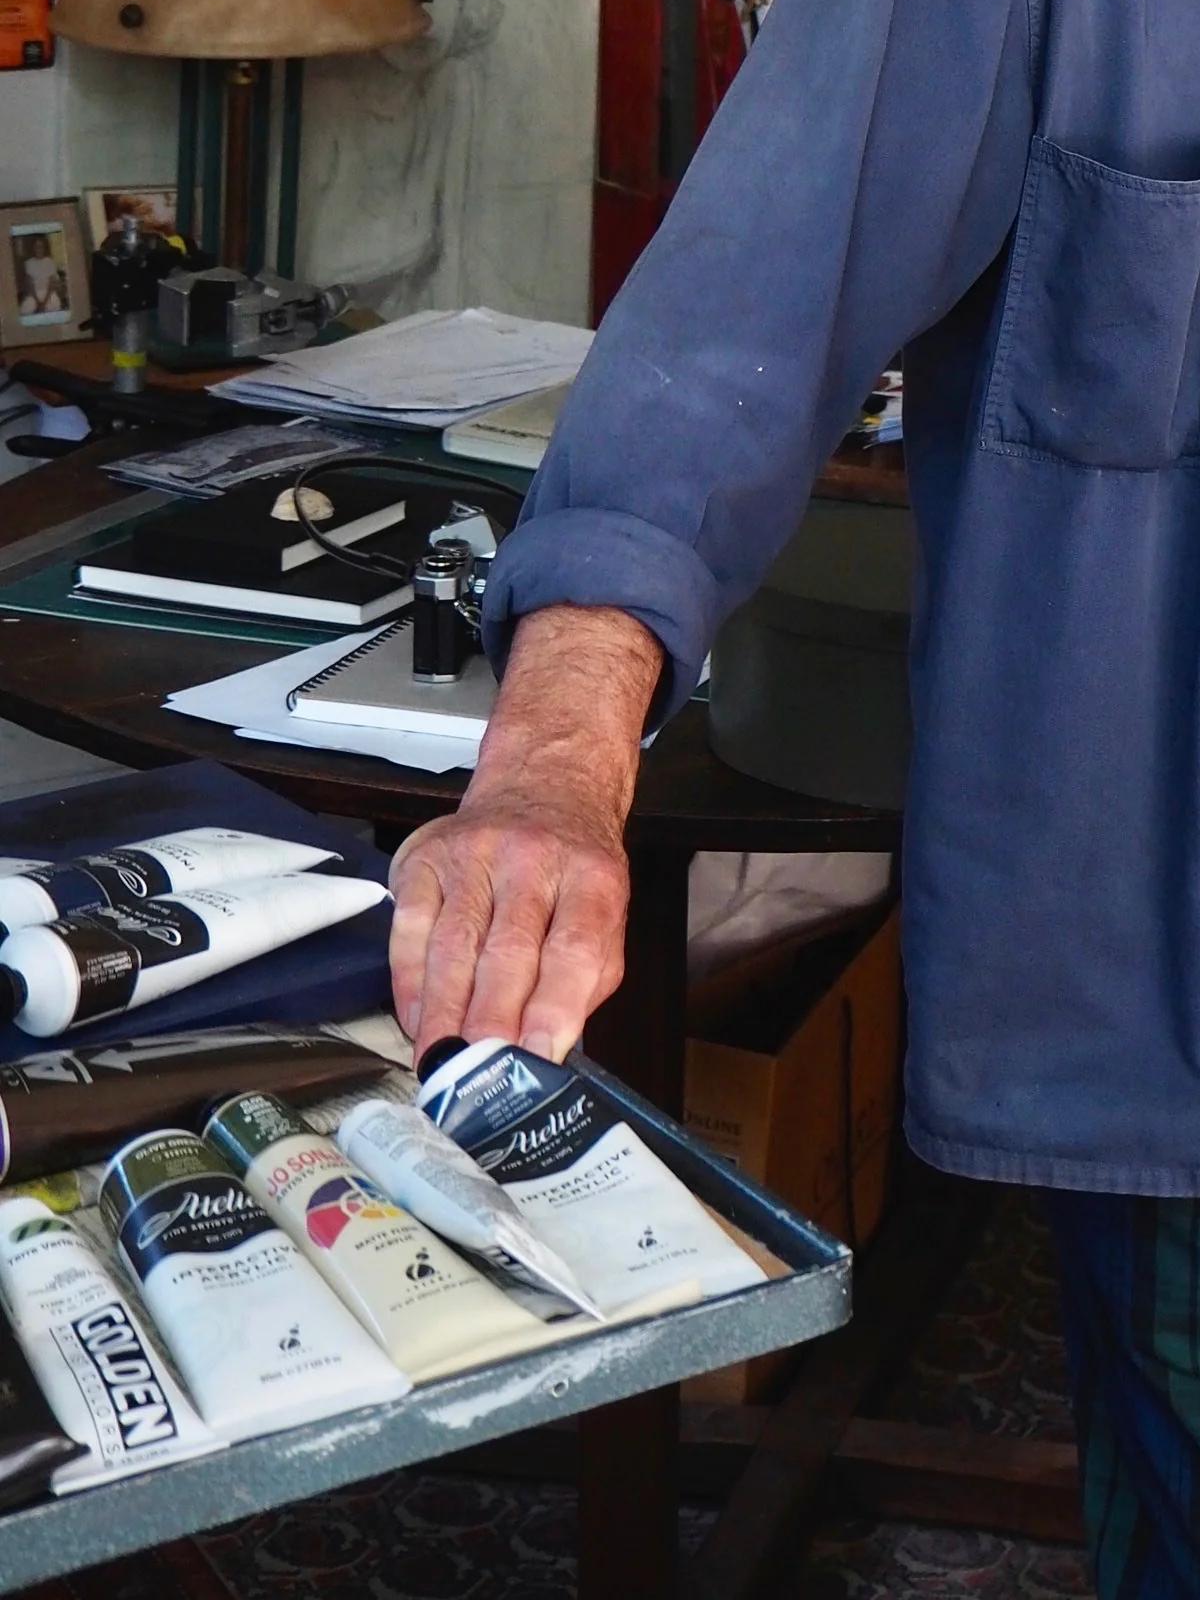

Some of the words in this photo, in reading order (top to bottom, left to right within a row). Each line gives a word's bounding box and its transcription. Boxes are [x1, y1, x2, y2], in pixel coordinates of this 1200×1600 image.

[488, 1051, 515, 1079] GREY
[476, 1093, 587, 1172] Atelier
[501, 1160, 523, 1172] FINE
[565, 1116, 593, 1139] PAINT
[134, 1140, 167, 1161] OLIVE
[267, 1166, 290, 1199] JO
[519, 1146, 634, 1205] INTERACTIVE
[548, 1166, 623, 1204] ACRYLIC
[161, 1224, 187, 1241] FINE
[355, 1230, 389, 1251] MATTE
[374, 1234, 414, 1252] ACRYLIC
[200, 1255, 289, 1284] ACRYLIC
[76, 1300, 177, 1449] GOLDEN
